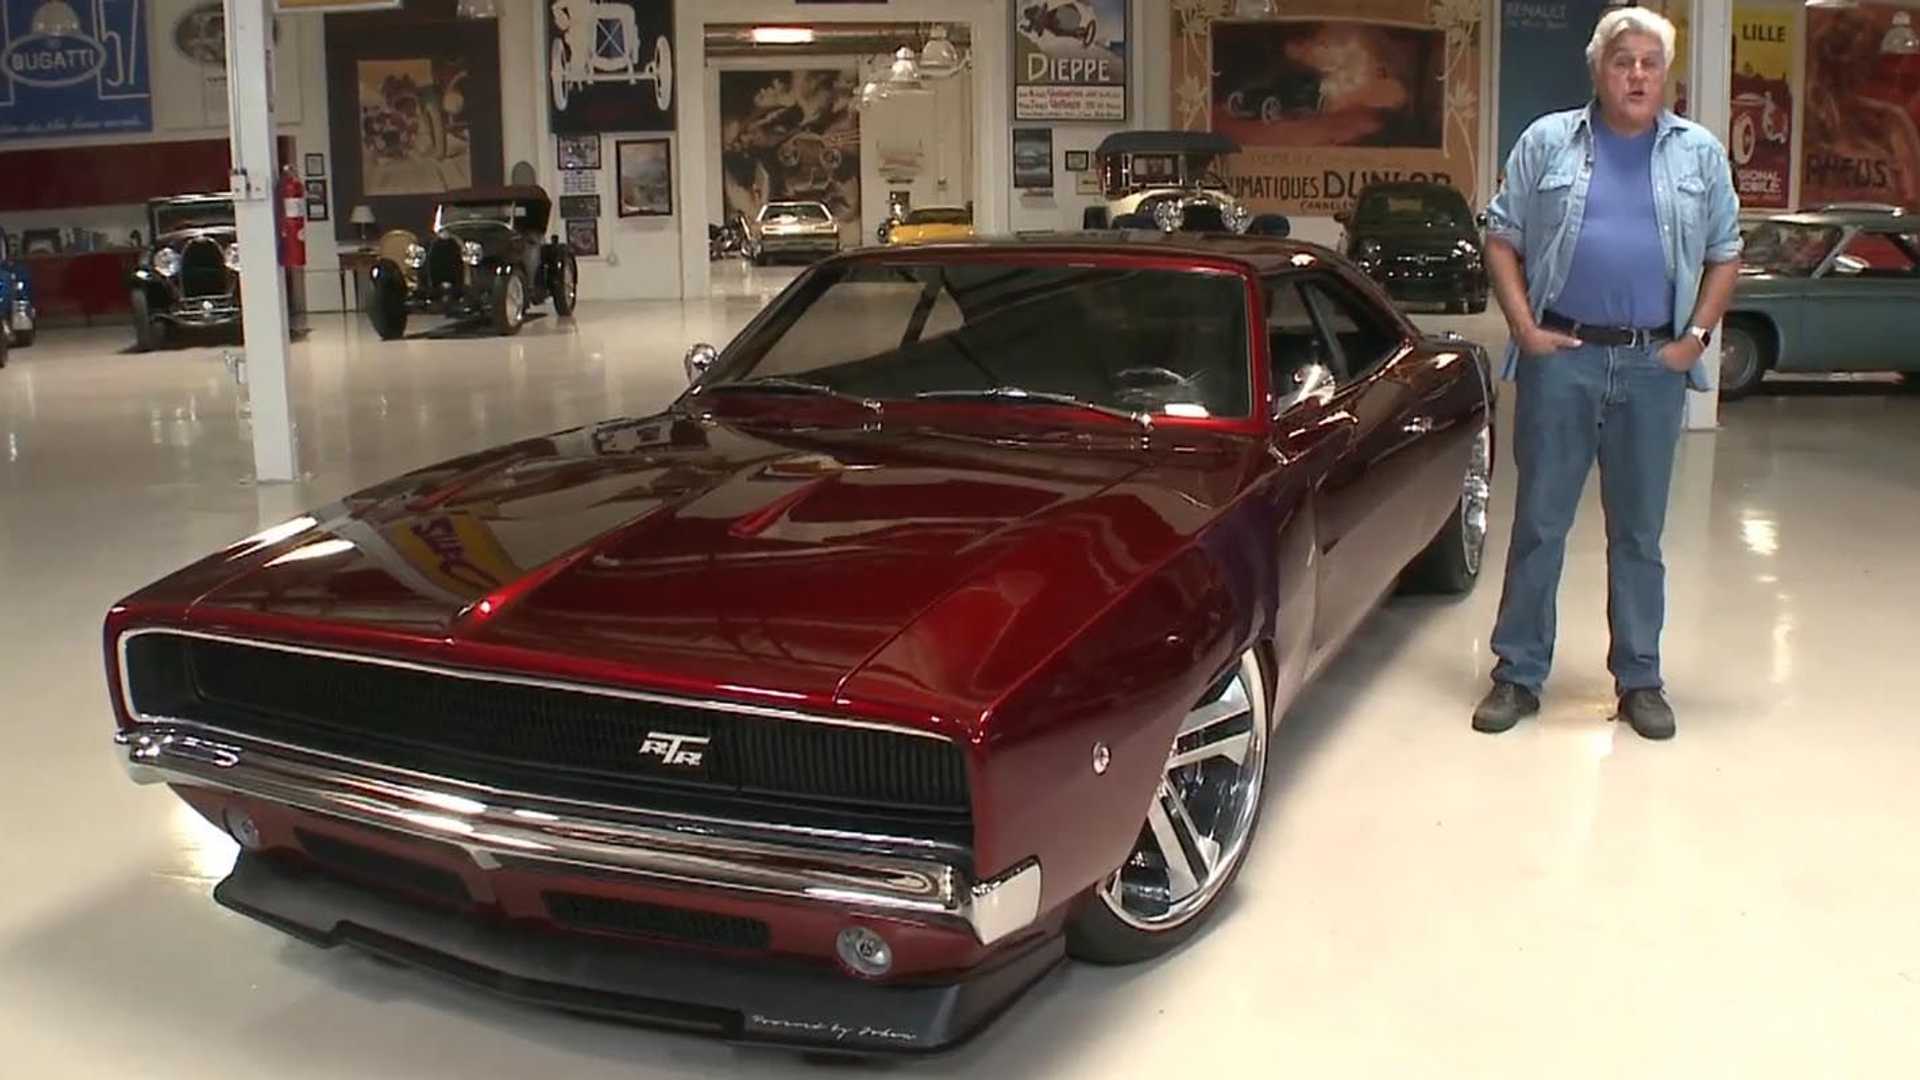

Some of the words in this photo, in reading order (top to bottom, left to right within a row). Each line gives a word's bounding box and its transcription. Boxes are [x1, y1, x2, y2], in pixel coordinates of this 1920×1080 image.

[1742, 23, 1786, 42] LILLE
[11, 48, 95, 71] BUGATTI
[1027, 52, 1110, 82] DIEPPE
[1230, 175, 1319, 200] UMATIQUES
[639, 732, 710, 766] RTR
[831, 1024, 853, 1040] by
